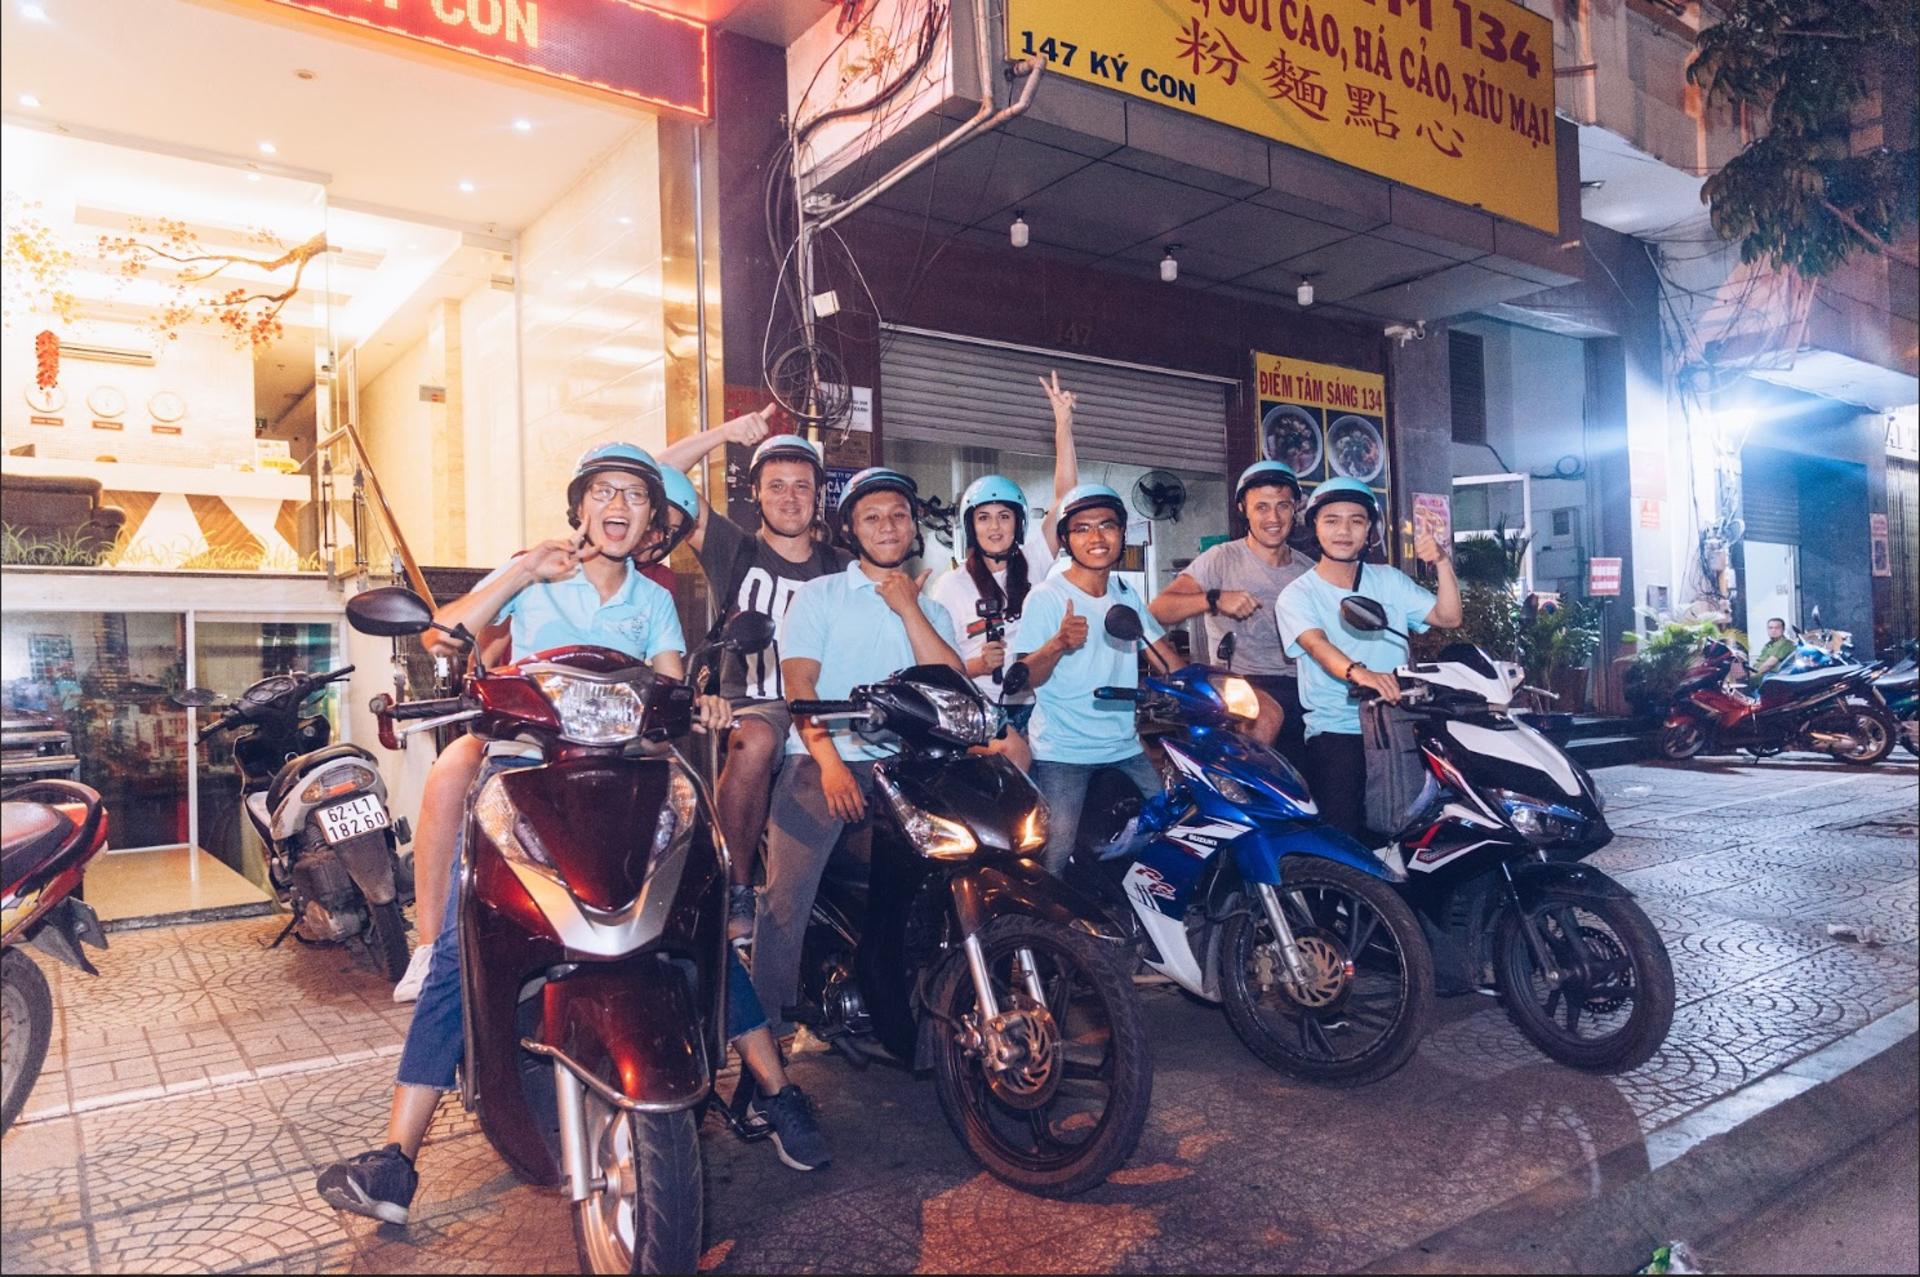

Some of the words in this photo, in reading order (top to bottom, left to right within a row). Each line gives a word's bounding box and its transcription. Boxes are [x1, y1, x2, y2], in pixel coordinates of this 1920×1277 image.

[431, 0, 538, 48] CON
[1453, 0, 1541, 79] 134
[1021, 31, 1078, 67] 147
[1090, 52, 1129, 83] KÝ
[1140, 67, 1196, 106] CON
[1353, 24, 1393, 81] HÁ
[1462, 68, 1504, 125] XÍU
[1509, 93, 1550, 149] MẠI
[1259, 360, 1293, 398] ĐIỂM
[1296, 372, 1323, 403] TÂM
[1327, 376, 1358, 410] SÁNG
[1361, 387, 1382, 412] 134
[329, 811, 385, 841] 182.60
[1188, 833, 1218, 847] SUZUKI
